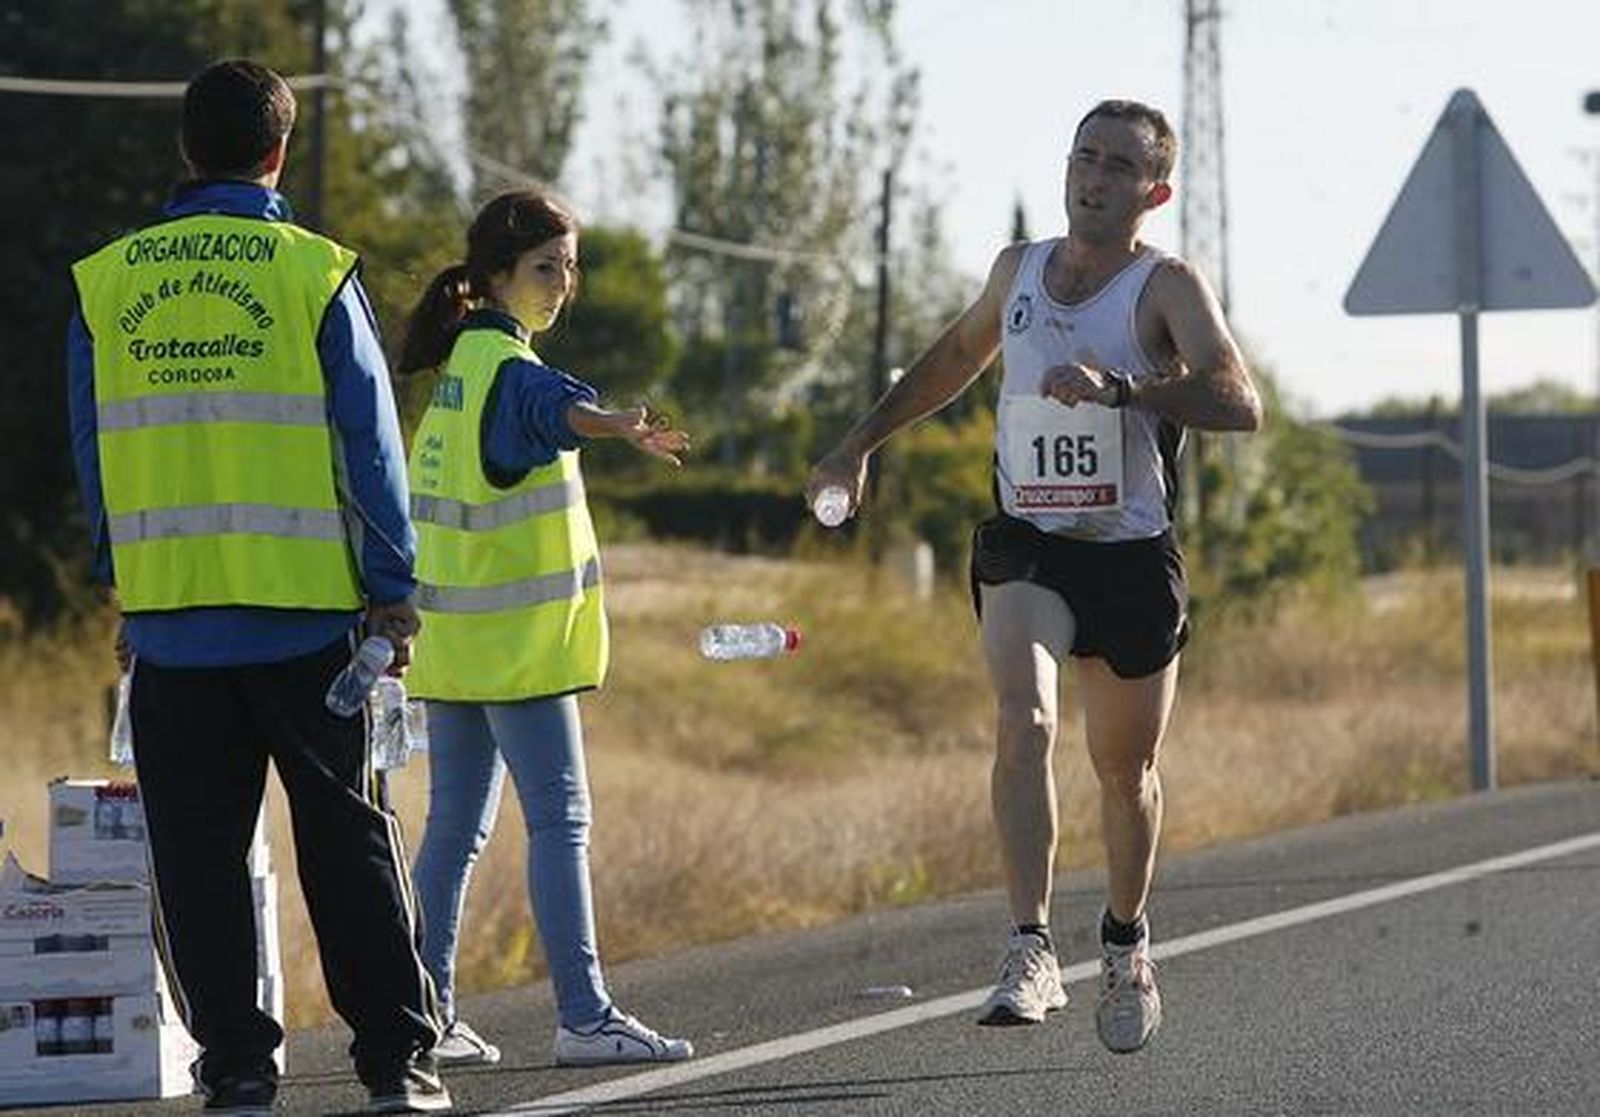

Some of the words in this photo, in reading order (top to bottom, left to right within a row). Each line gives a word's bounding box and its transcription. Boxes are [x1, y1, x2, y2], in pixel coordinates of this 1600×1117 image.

[126, 234, 277, 265] ORGANIZACION
[120, 292, 156, 334] Club
[159, 278, 182, 299] de
[189, 271, 274, 330] Atletismo
[129, 335, 264, 362] Trotacalles
[1032, 435, 1098, 477] 165
